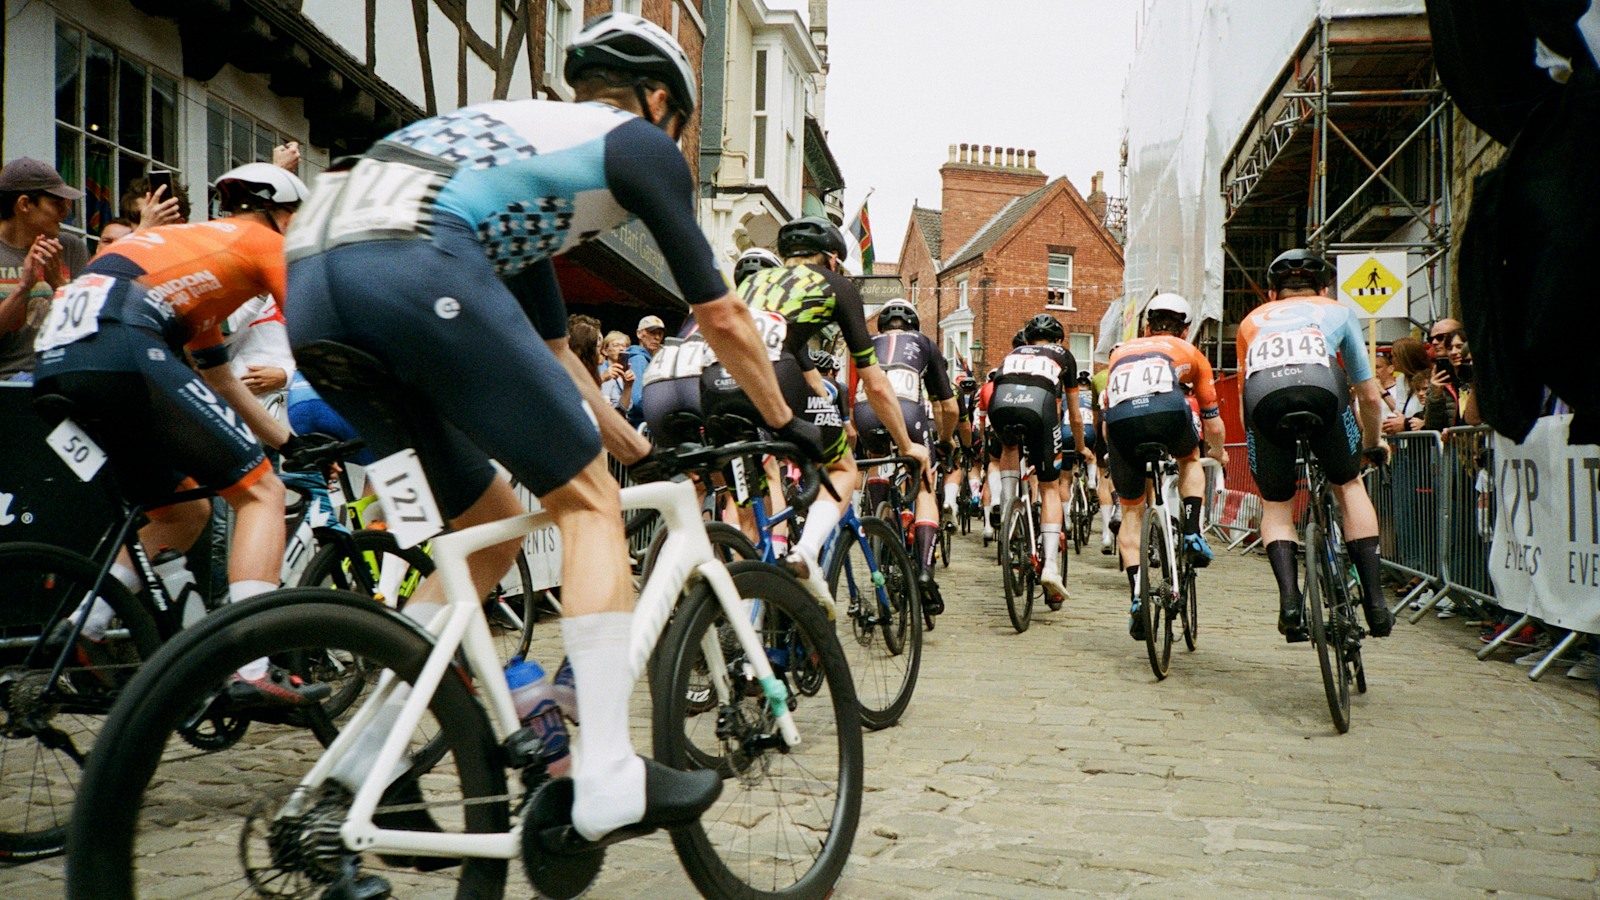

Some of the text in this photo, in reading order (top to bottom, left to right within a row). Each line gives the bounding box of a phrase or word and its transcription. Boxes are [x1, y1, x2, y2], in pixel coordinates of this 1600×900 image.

[143, 269, 219, 309] LONDON
[861, 284, 901, 294] cafe zoot
[57, 290, 89, 332] 50
[1248, 335, 1327, 368] 143 143
[1111, 371, 1131, 396] 47
[1143, 365, 1163, 386] 47
[1284, 366, 1303, 377] COL
[63, 435, 89, 464] 50
[384, 471, 428, 523] 127
[1567, 457, 1600, 544] IT
